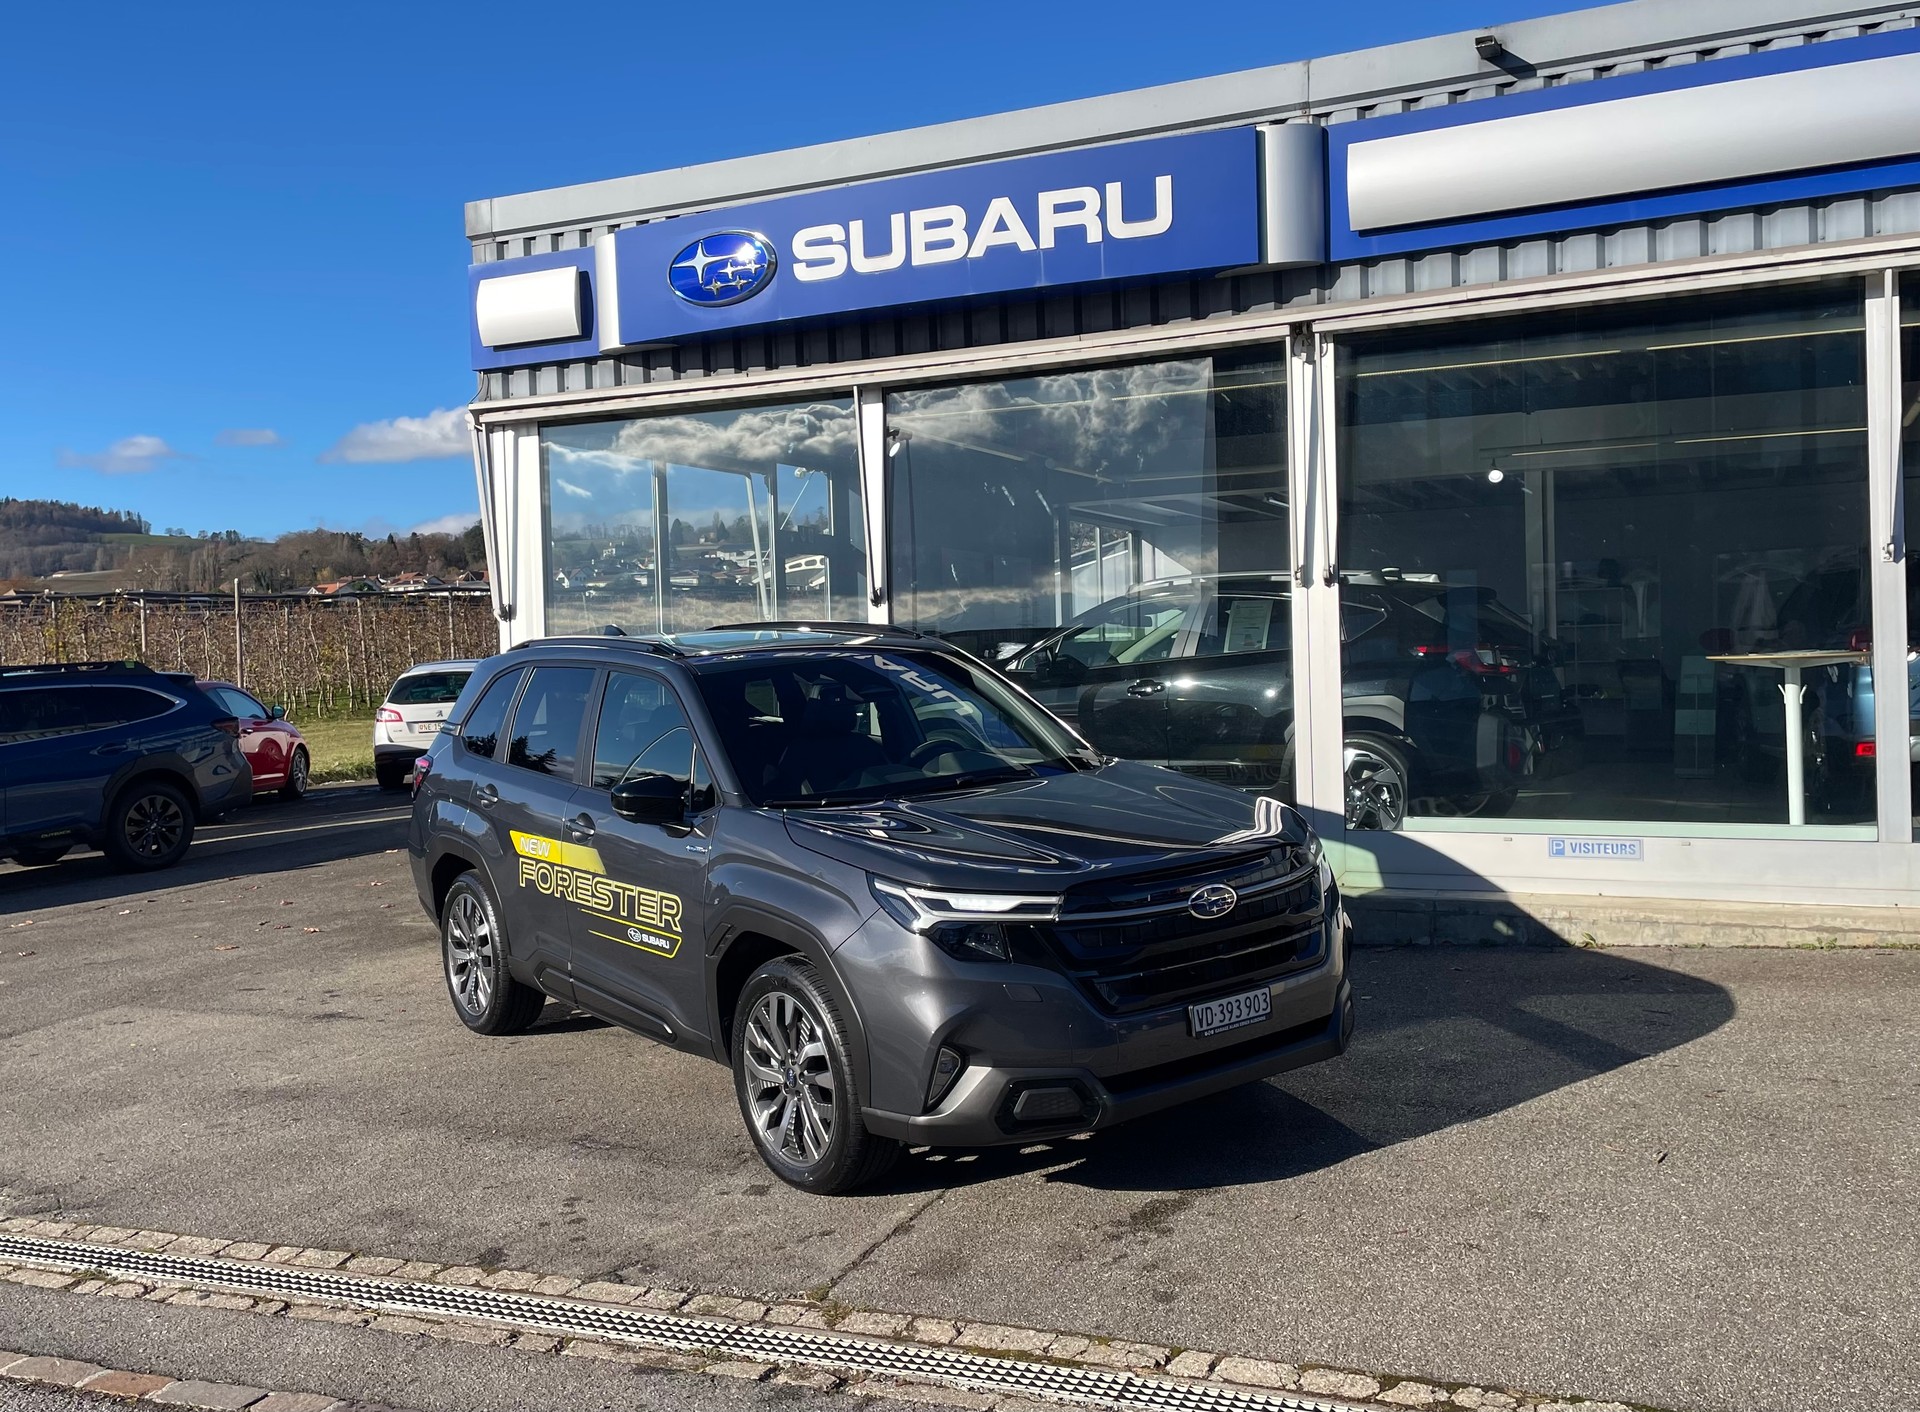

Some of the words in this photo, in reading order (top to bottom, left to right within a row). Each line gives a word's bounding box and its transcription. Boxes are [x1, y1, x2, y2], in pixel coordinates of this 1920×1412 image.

[792, 174, 1174, 282] SUBARU
[519, 836, 551, 858] NEW
[1569, 841, 1636, 855] VISITEURS
[519, 857, 682, 933] FORESTER
[641, 933, 670, 949] SUBARU
